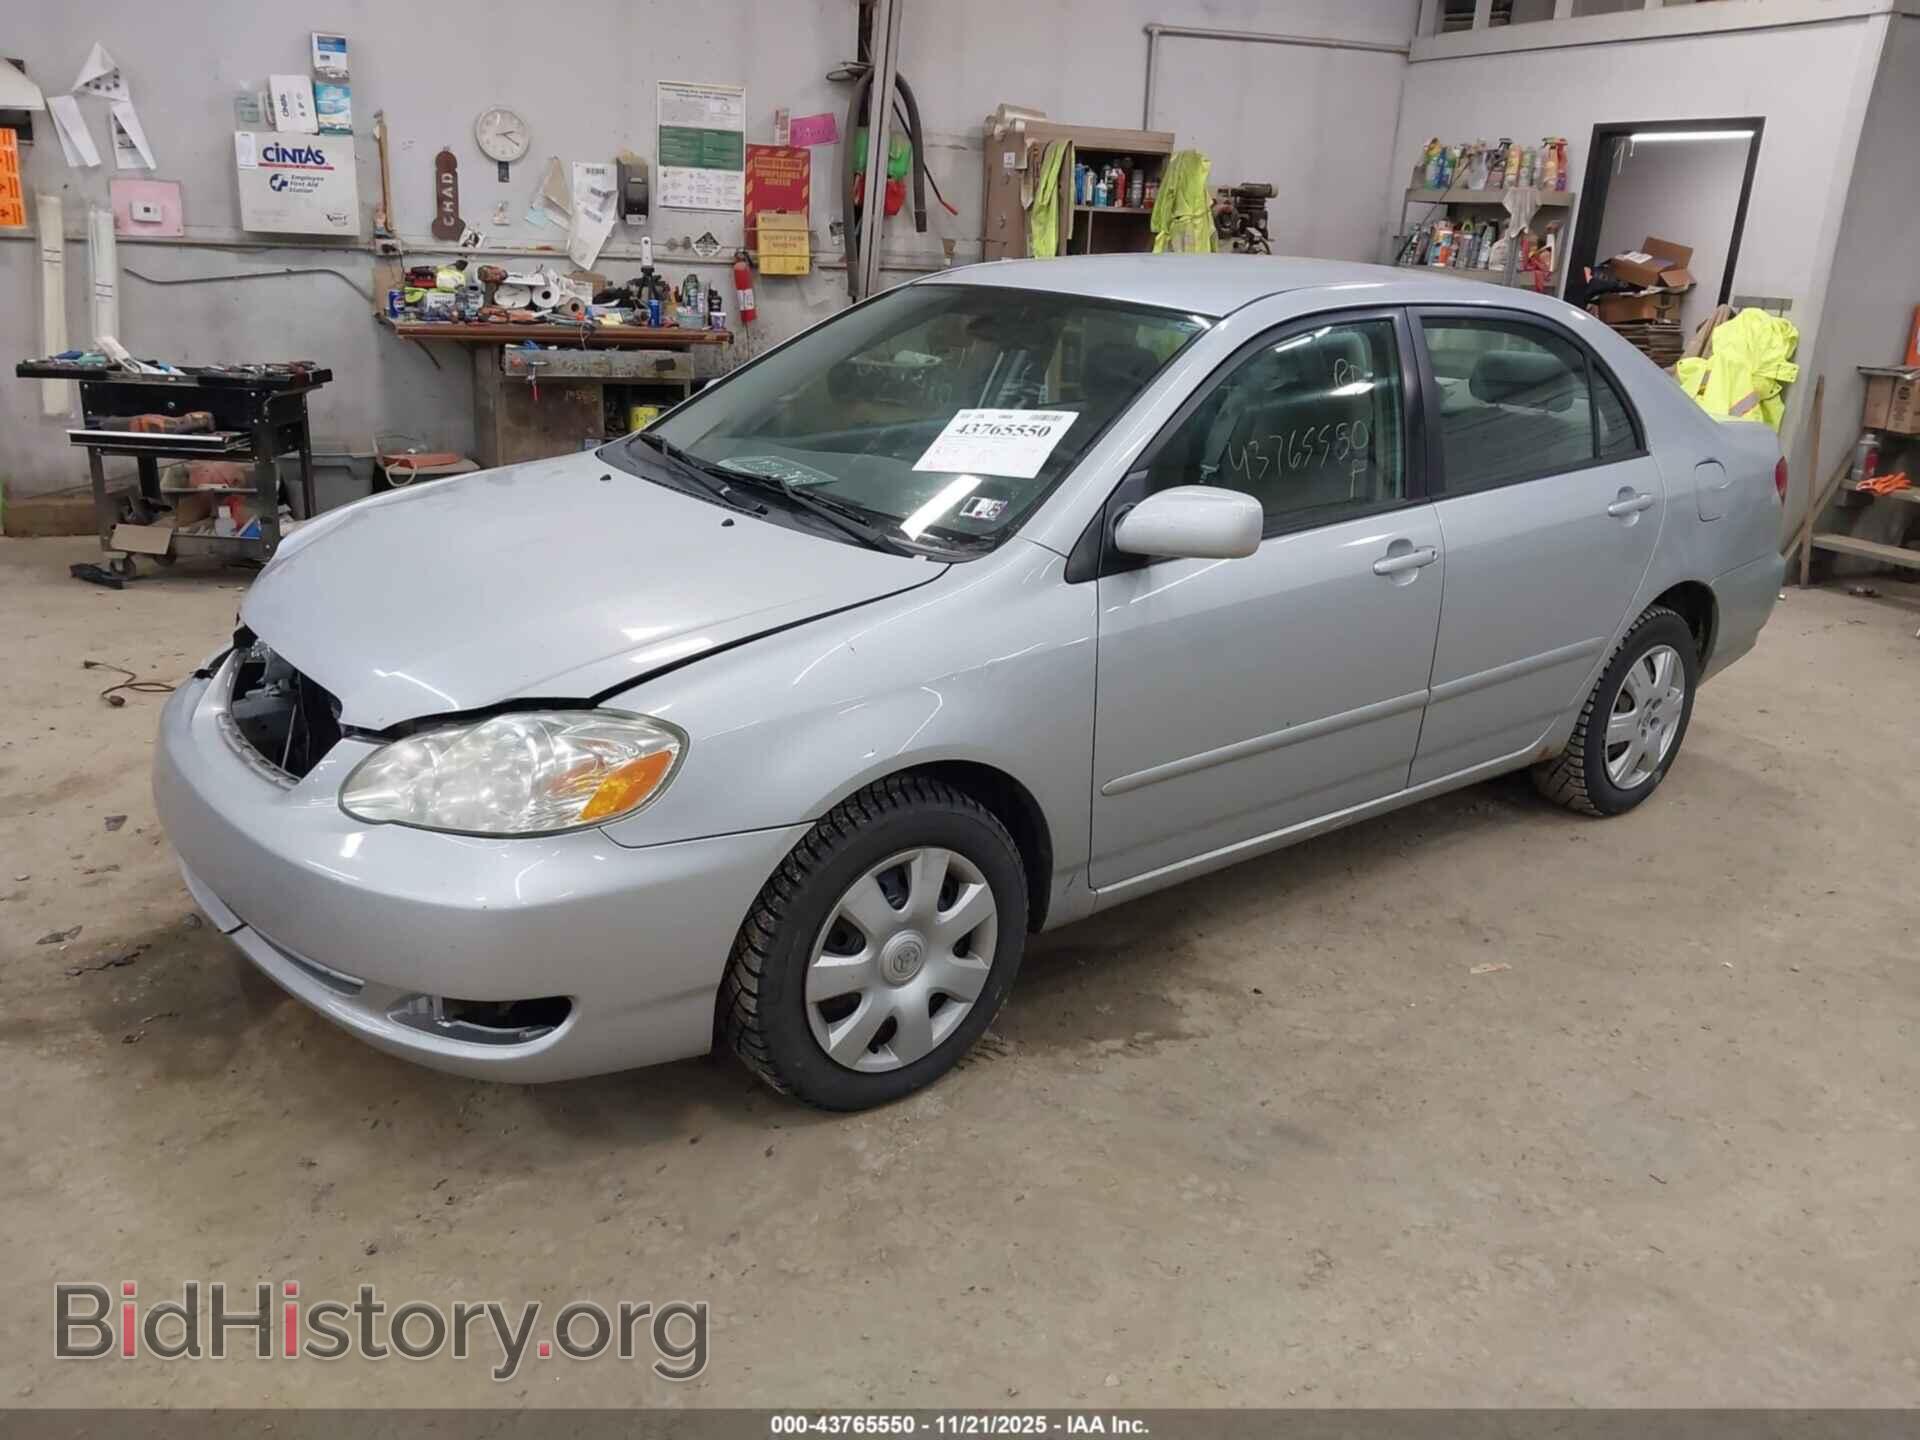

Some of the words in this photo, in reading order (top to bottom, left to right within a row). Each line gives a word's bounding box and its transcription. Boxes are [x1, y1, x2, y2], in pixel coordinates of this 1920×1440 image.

[441, 172, 455, 226] CHAD
[955, 422, 1052, 438] 43765550
[1228, 420, 1369, 480] 43765550
